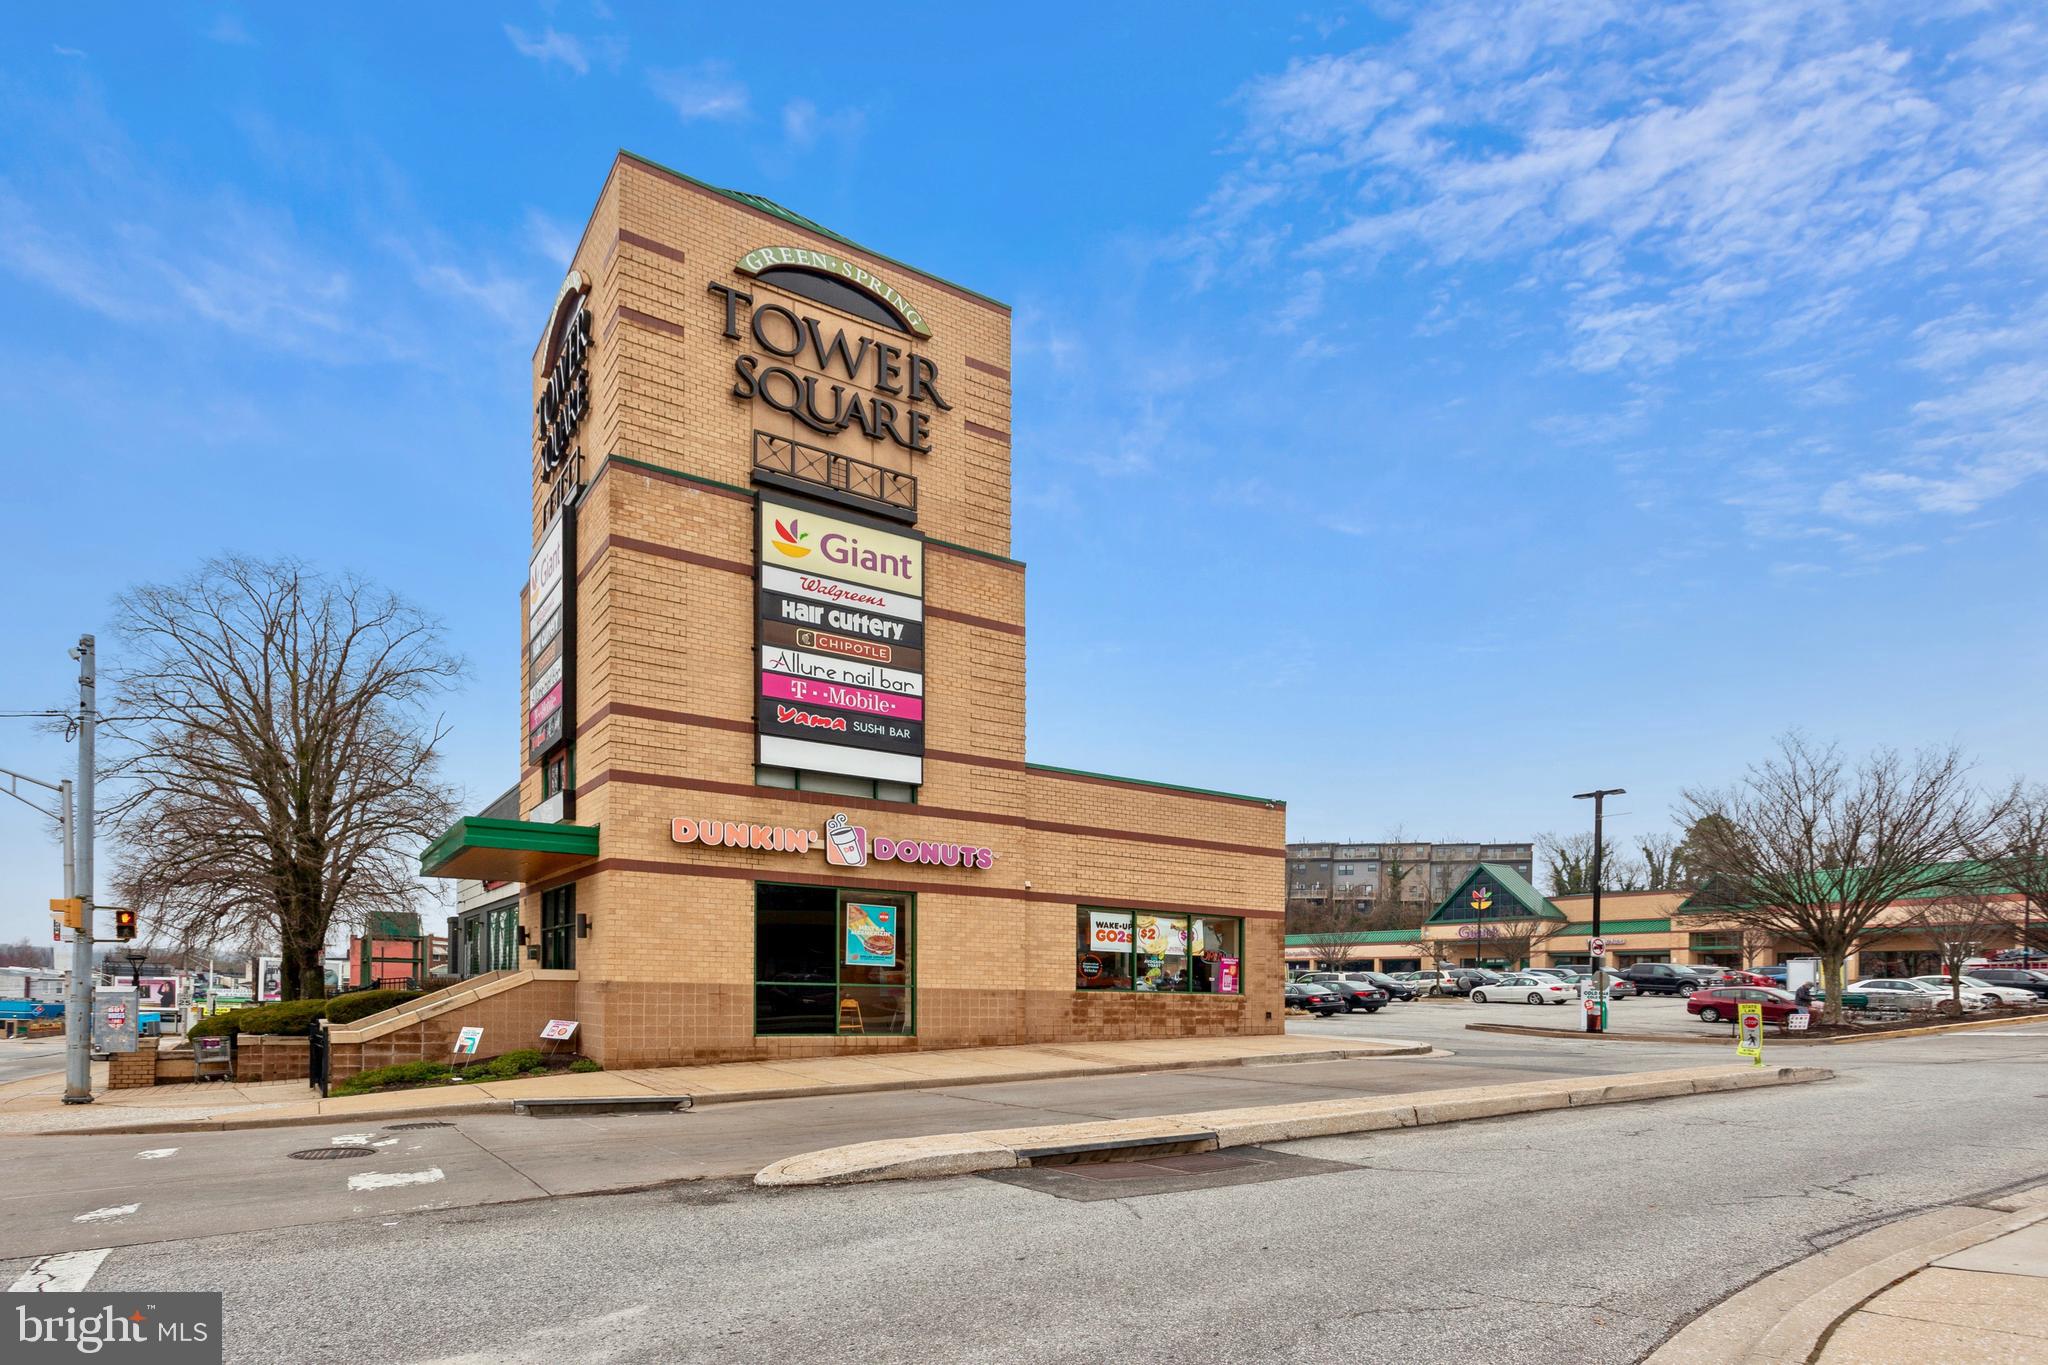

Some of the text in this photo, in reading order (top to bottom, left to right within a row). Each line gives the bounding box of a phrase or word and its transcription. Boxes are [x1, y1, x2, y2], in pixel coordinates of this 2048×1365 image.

[746, 247, 922, 327] GREEN SPRING
[708, 281, 953, 411] TOWER
[731, 353, 932, 455] SQUARE
[820, 533, 913, 579] Giant
[800, 576, 886, 607] Walgreens
[819, 637, 888, 659] CHIPOTLE
[769, 651, 914, 693] Allure nail bar
[853, 721, 885, 735] SUSHI
[889, 727, 911, 739] BAR
[672, 817, 818, 853] DUNKIN'
[873, 837, 993, 870] DONUTS
[1141, 928, 1156, 940] $2
